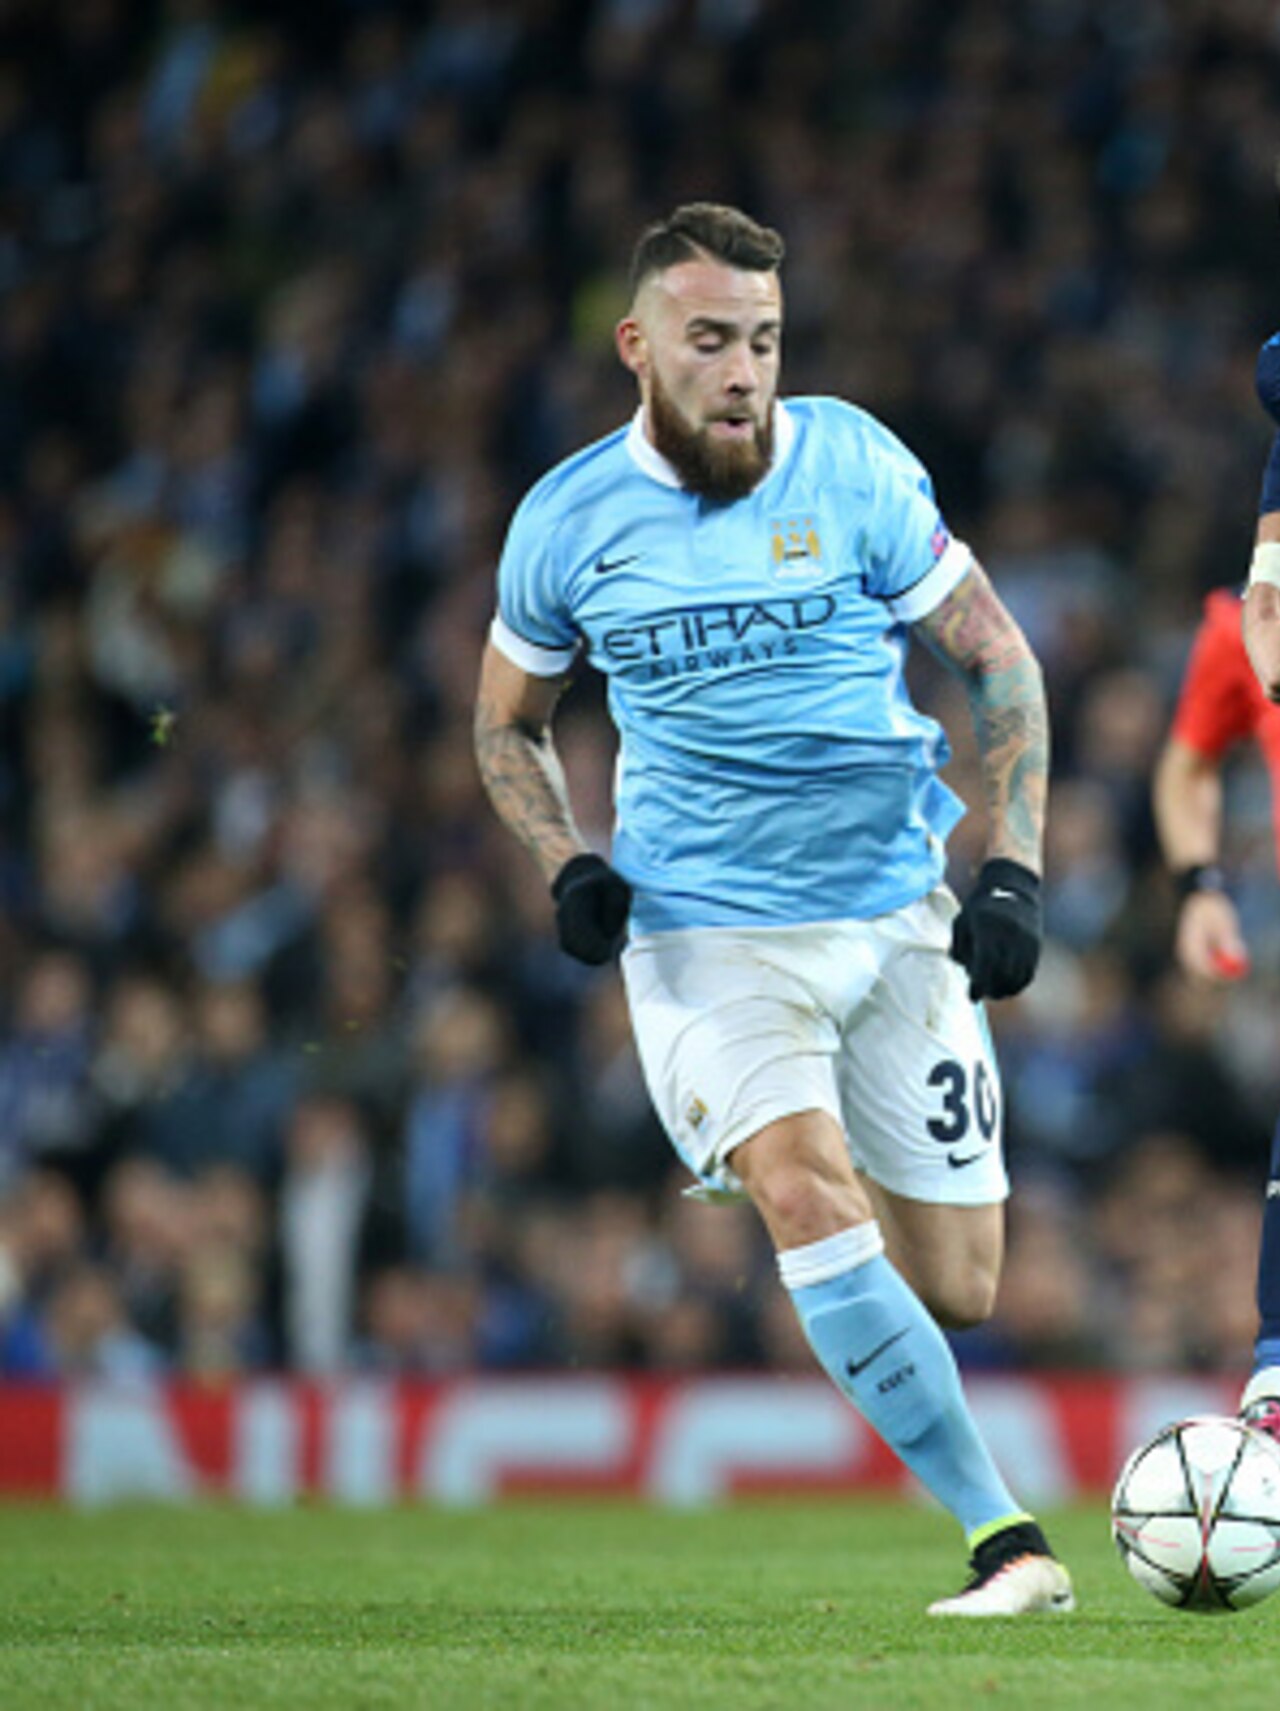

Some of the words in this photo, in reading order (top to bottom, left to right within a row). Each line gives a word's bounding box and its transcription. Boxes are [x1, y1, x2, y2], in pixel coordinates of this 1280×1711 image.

[603, 594, 837, 661] ETIHAD
[651, 637, 799, 679] AIRWAYS
[926, 1059, 997, 1143] 30
